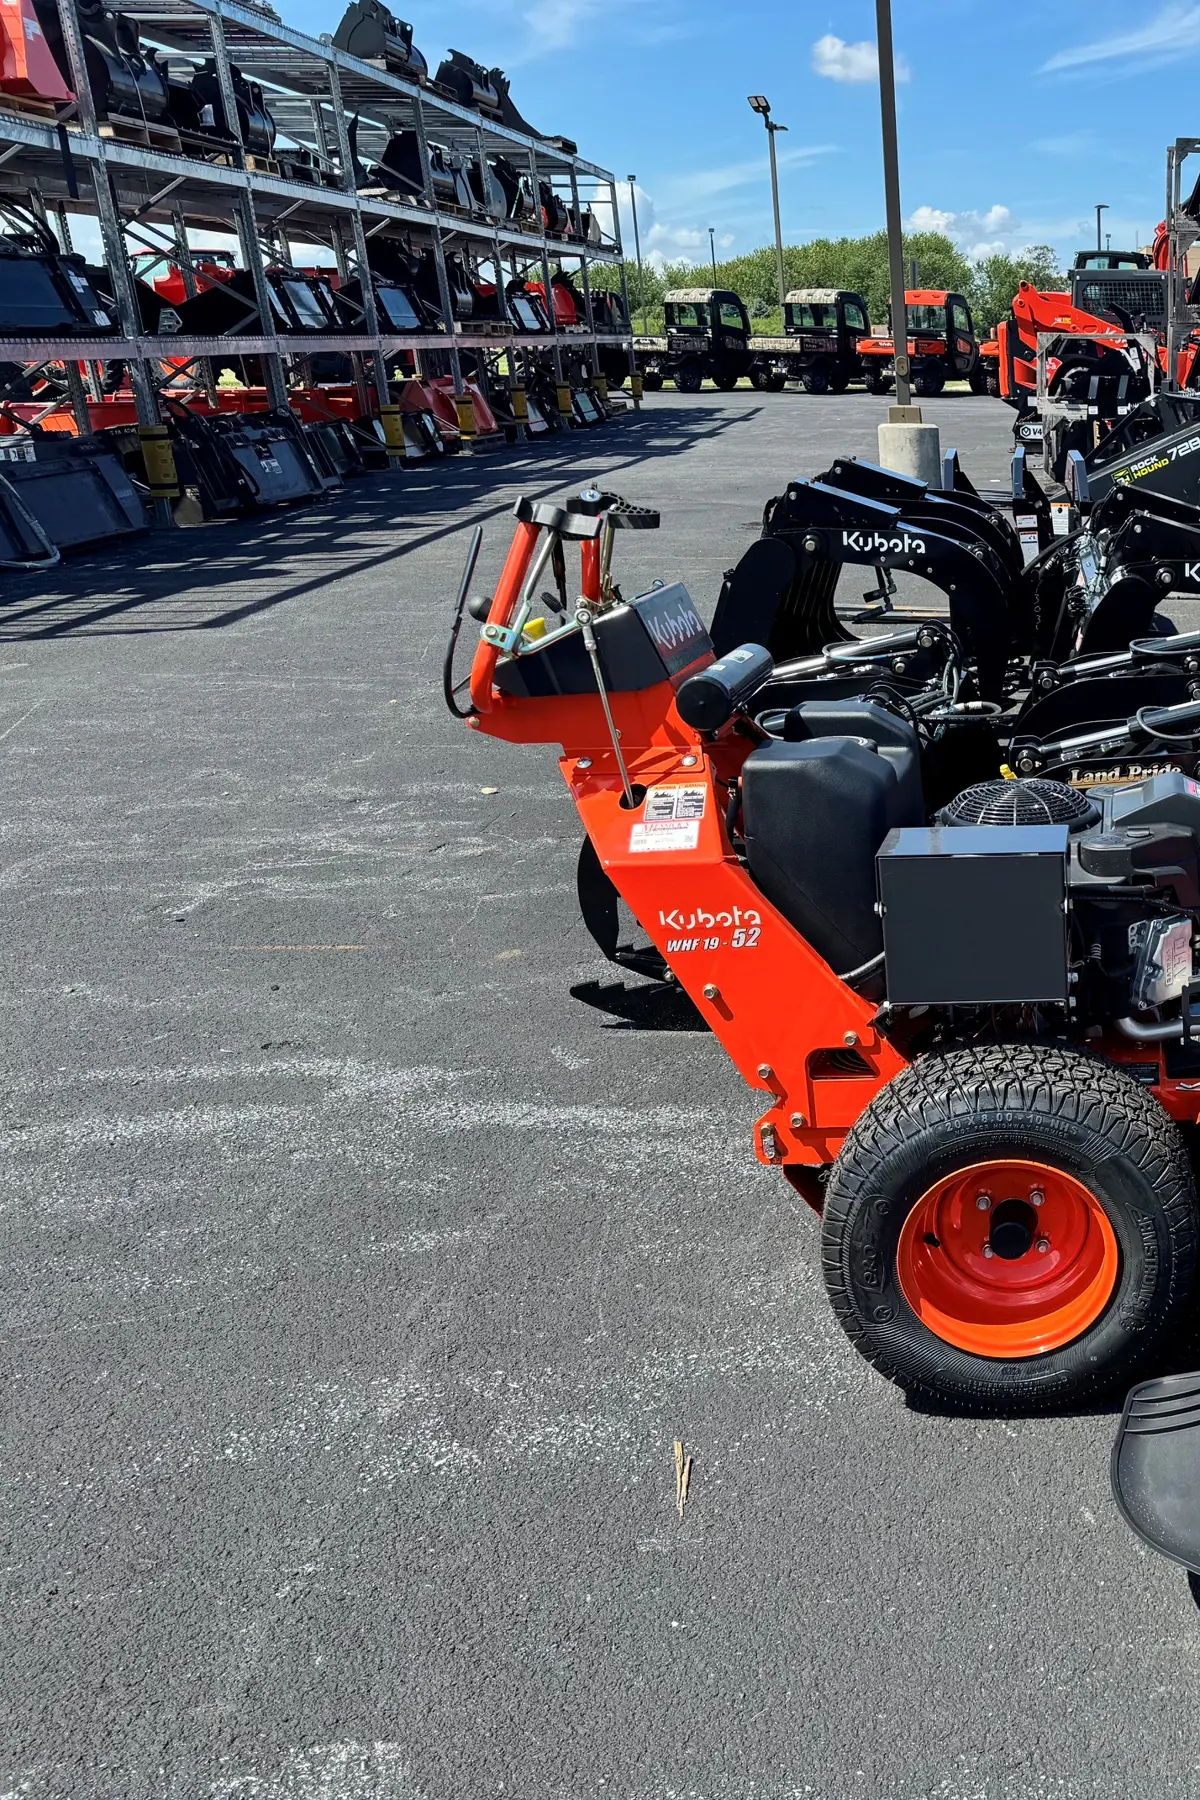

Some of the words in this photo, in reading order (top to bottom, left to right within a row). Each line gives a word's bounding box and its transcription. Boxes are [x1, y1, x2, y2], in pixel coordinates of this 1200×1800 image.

[1130, 455, 1159, 473] ROCK
[1133, 458, 1170, 480] HOUND
[842, 530, 926, 554] Kubota
[647, 604, 703, 650] Kubota
[1069, 765, 1121, 784] Land
[1126, 762, 1182, 781] Pride
[658, 905, 762, 930] Kubota
[666, 938, 701, 953] WHF
[703, 936, 720, 951] 19
[731, 927, 762, 949] 52
[993, 1122, 1031, 1130] HIGHWAY
[1034, 1125, 1069, 1139] SERVICE
